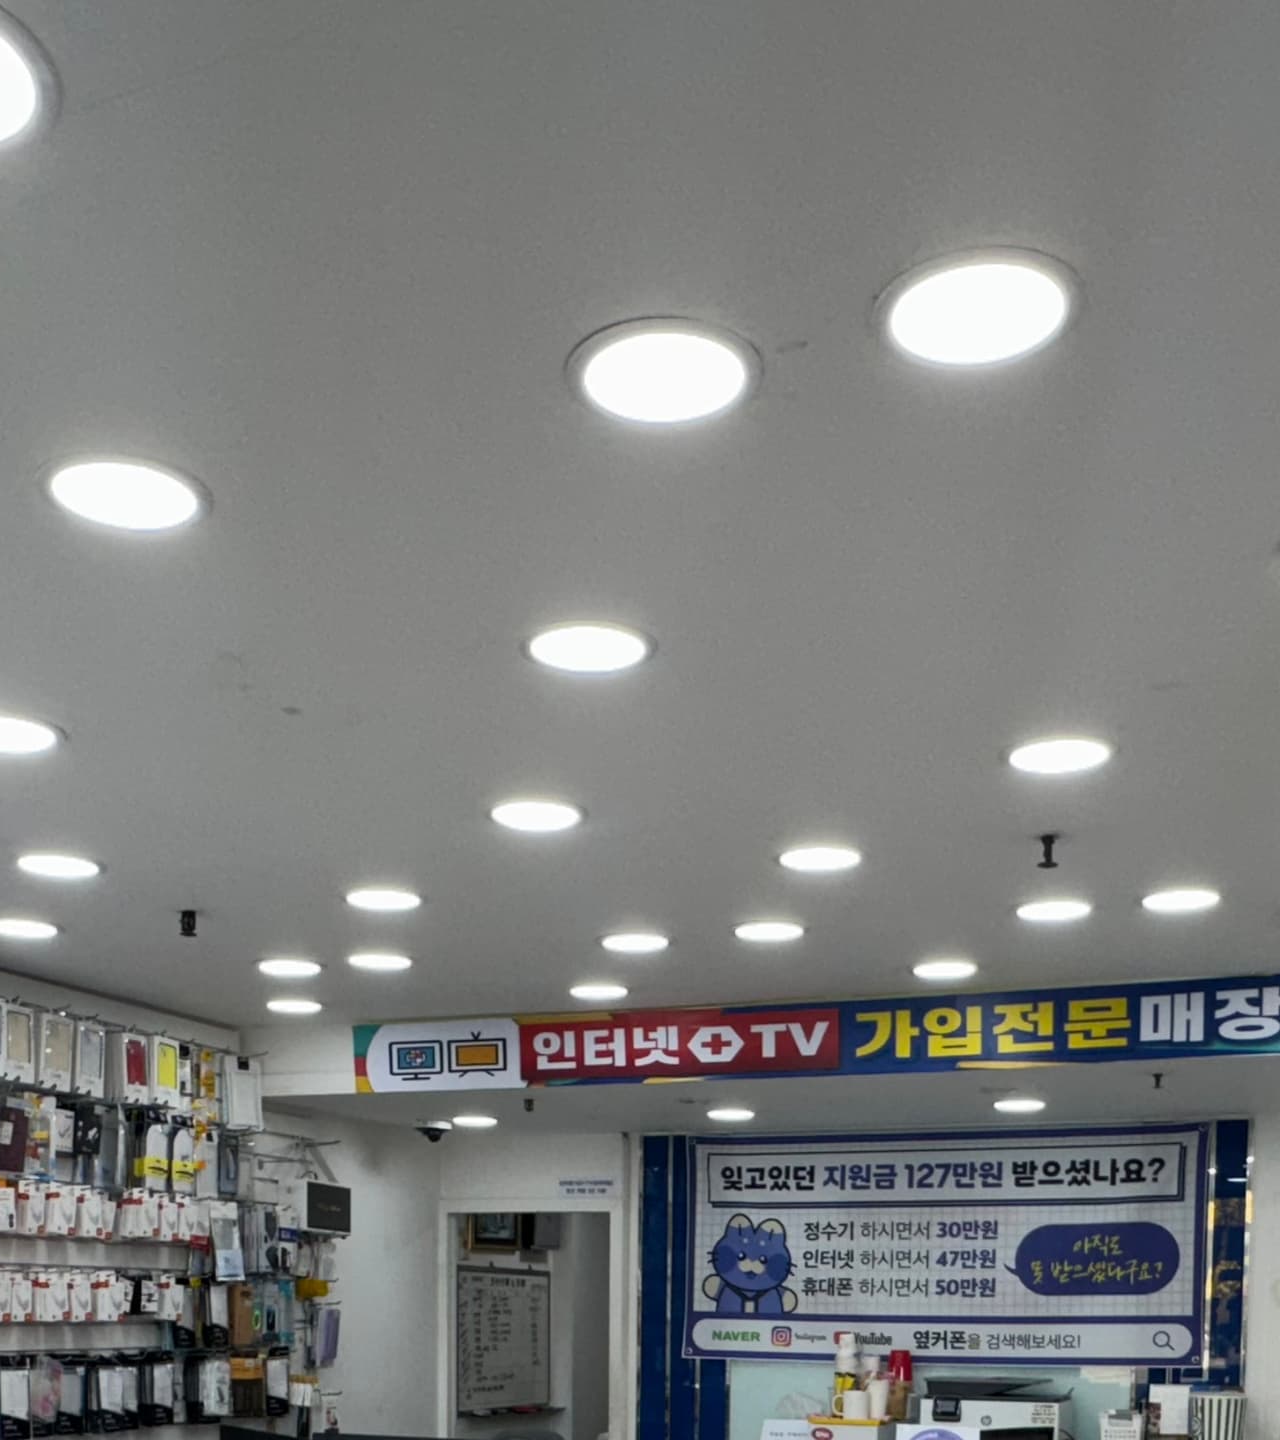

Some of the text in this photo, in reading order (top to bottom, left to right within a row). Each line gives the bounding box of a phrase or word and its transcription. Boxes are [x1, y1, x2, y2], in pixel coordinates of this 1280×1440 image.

[532, 1025, 680, 1071] 인터넷
[750, 1021, 829, 1058] TV
[722, 1157, 1166, 1191] 잊고있던 지원금 127만원 받으셨나요?
[804, 1220, 998, 1241] 정수기 하시면서 30만원
[1073, 1235, 1124, 1255] 아직도
[803, 1249, 997, 1269] 인터넷 하시면서 47만원
[802, 1278, 996, 1298] 휴대폰 하시면서 50만원
[712, 1330, 760, 1342] NAVER
[913, 1330, 1082, 1350] 옆커폰을 검색해보세요!
